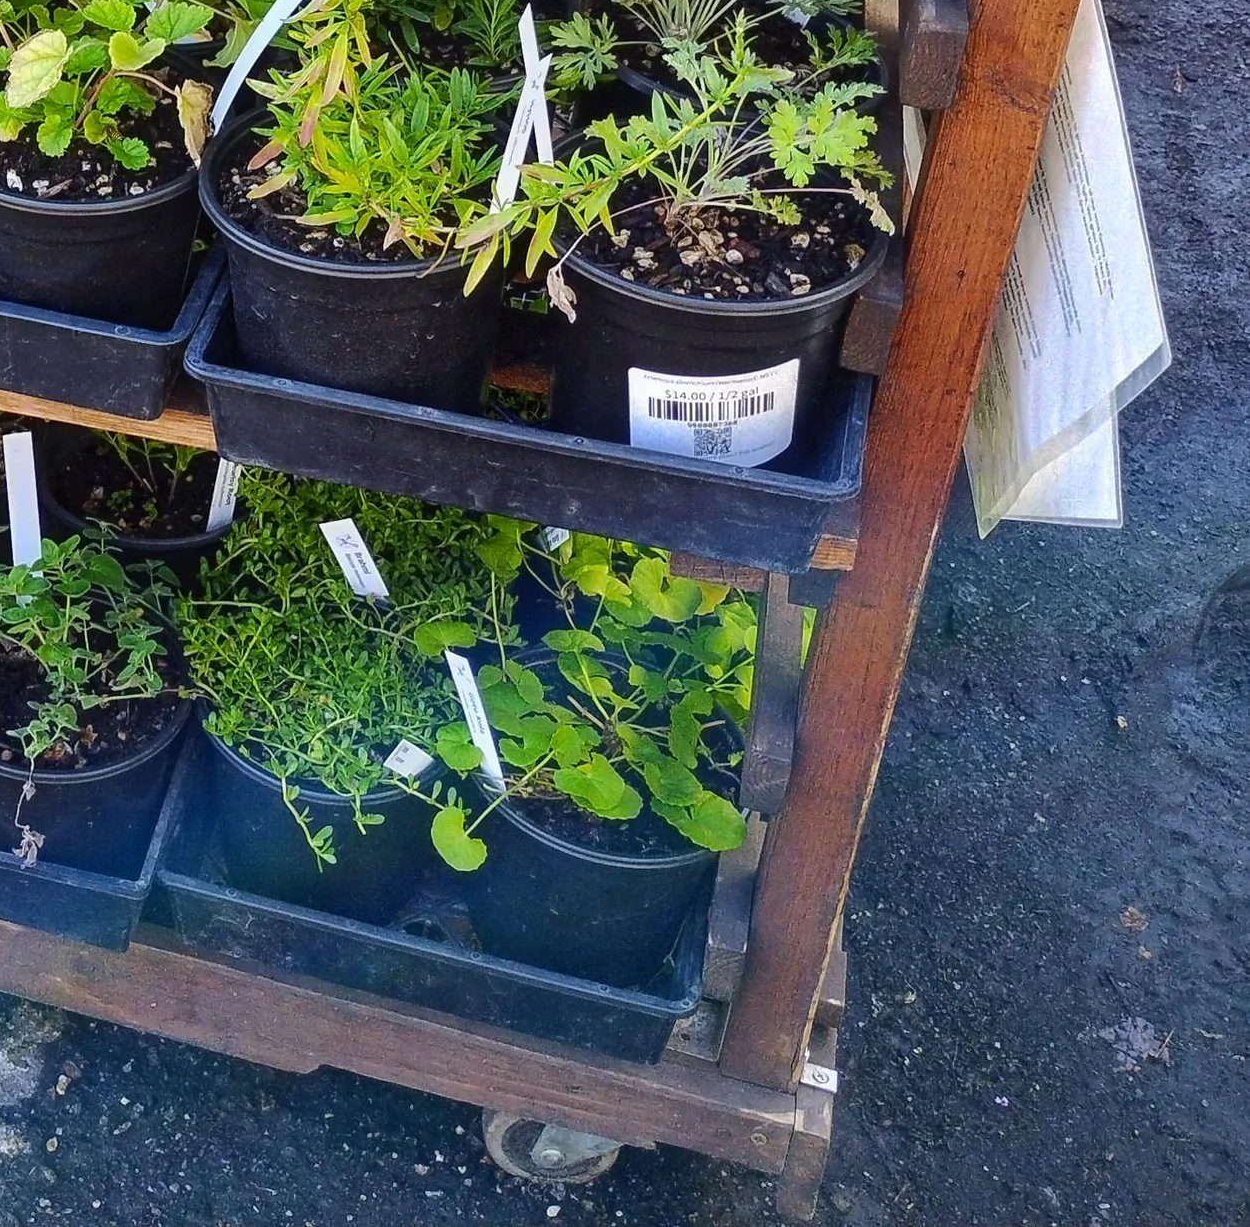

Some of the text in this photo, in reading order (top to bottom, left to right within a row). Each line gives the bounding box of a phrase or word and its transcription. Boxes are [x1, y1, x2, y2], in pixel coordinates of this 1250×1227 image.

[665, 389, 706, 400] $14.00
[719, 390, 738, 400] 1/2
[741, 387, 759, 401] gal
